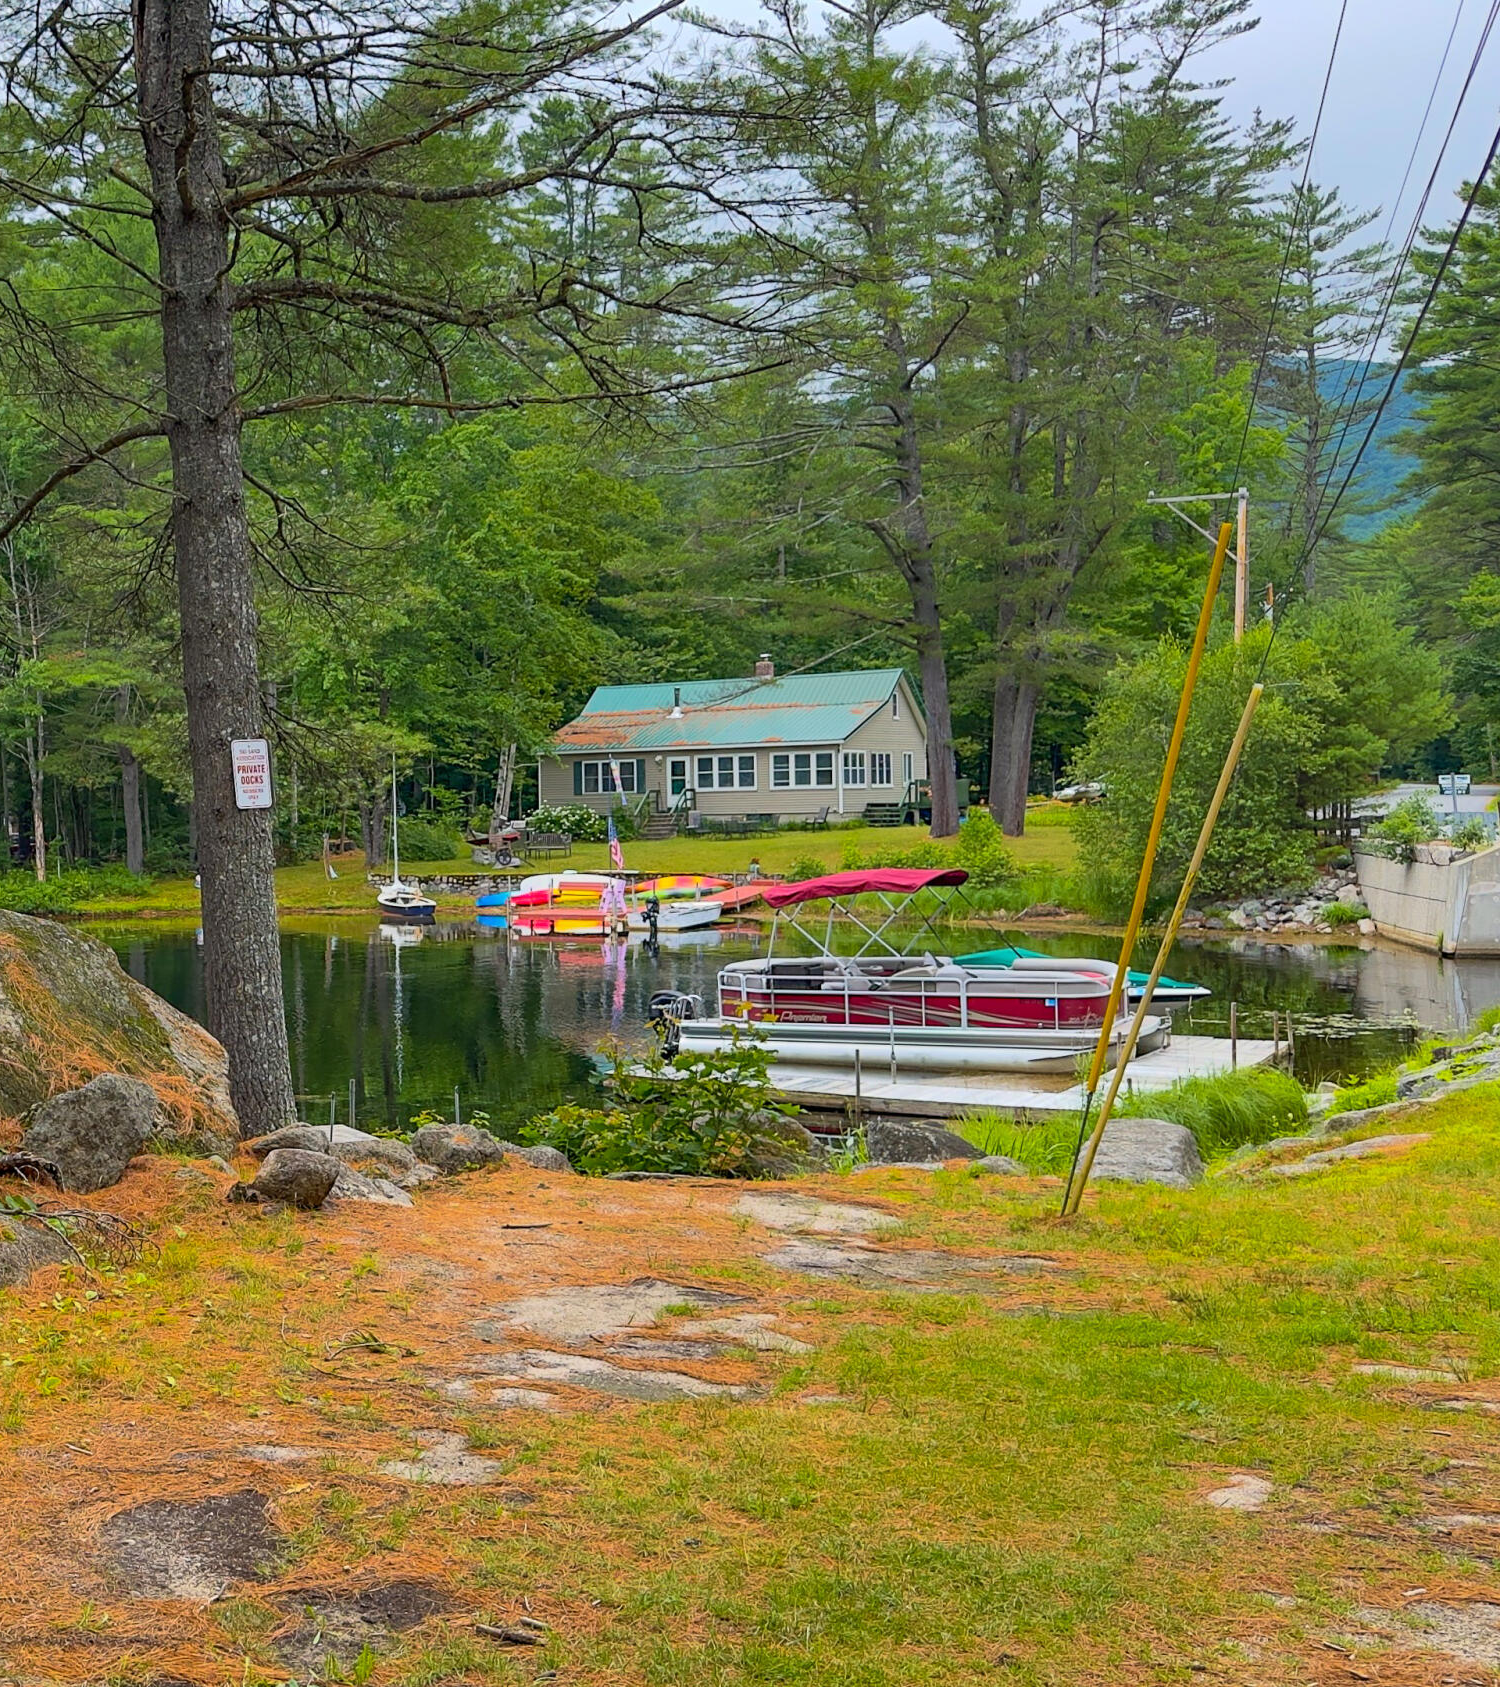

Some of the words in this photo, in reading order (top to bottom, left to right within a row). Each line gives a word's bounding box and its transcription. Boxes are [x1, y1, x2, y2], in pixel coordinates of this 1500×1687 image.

[237, 765, 265, 774] PRIVATE
[241, 776, 263, 784] DOCKS
[780, 1011, 827, 1023] Premier
